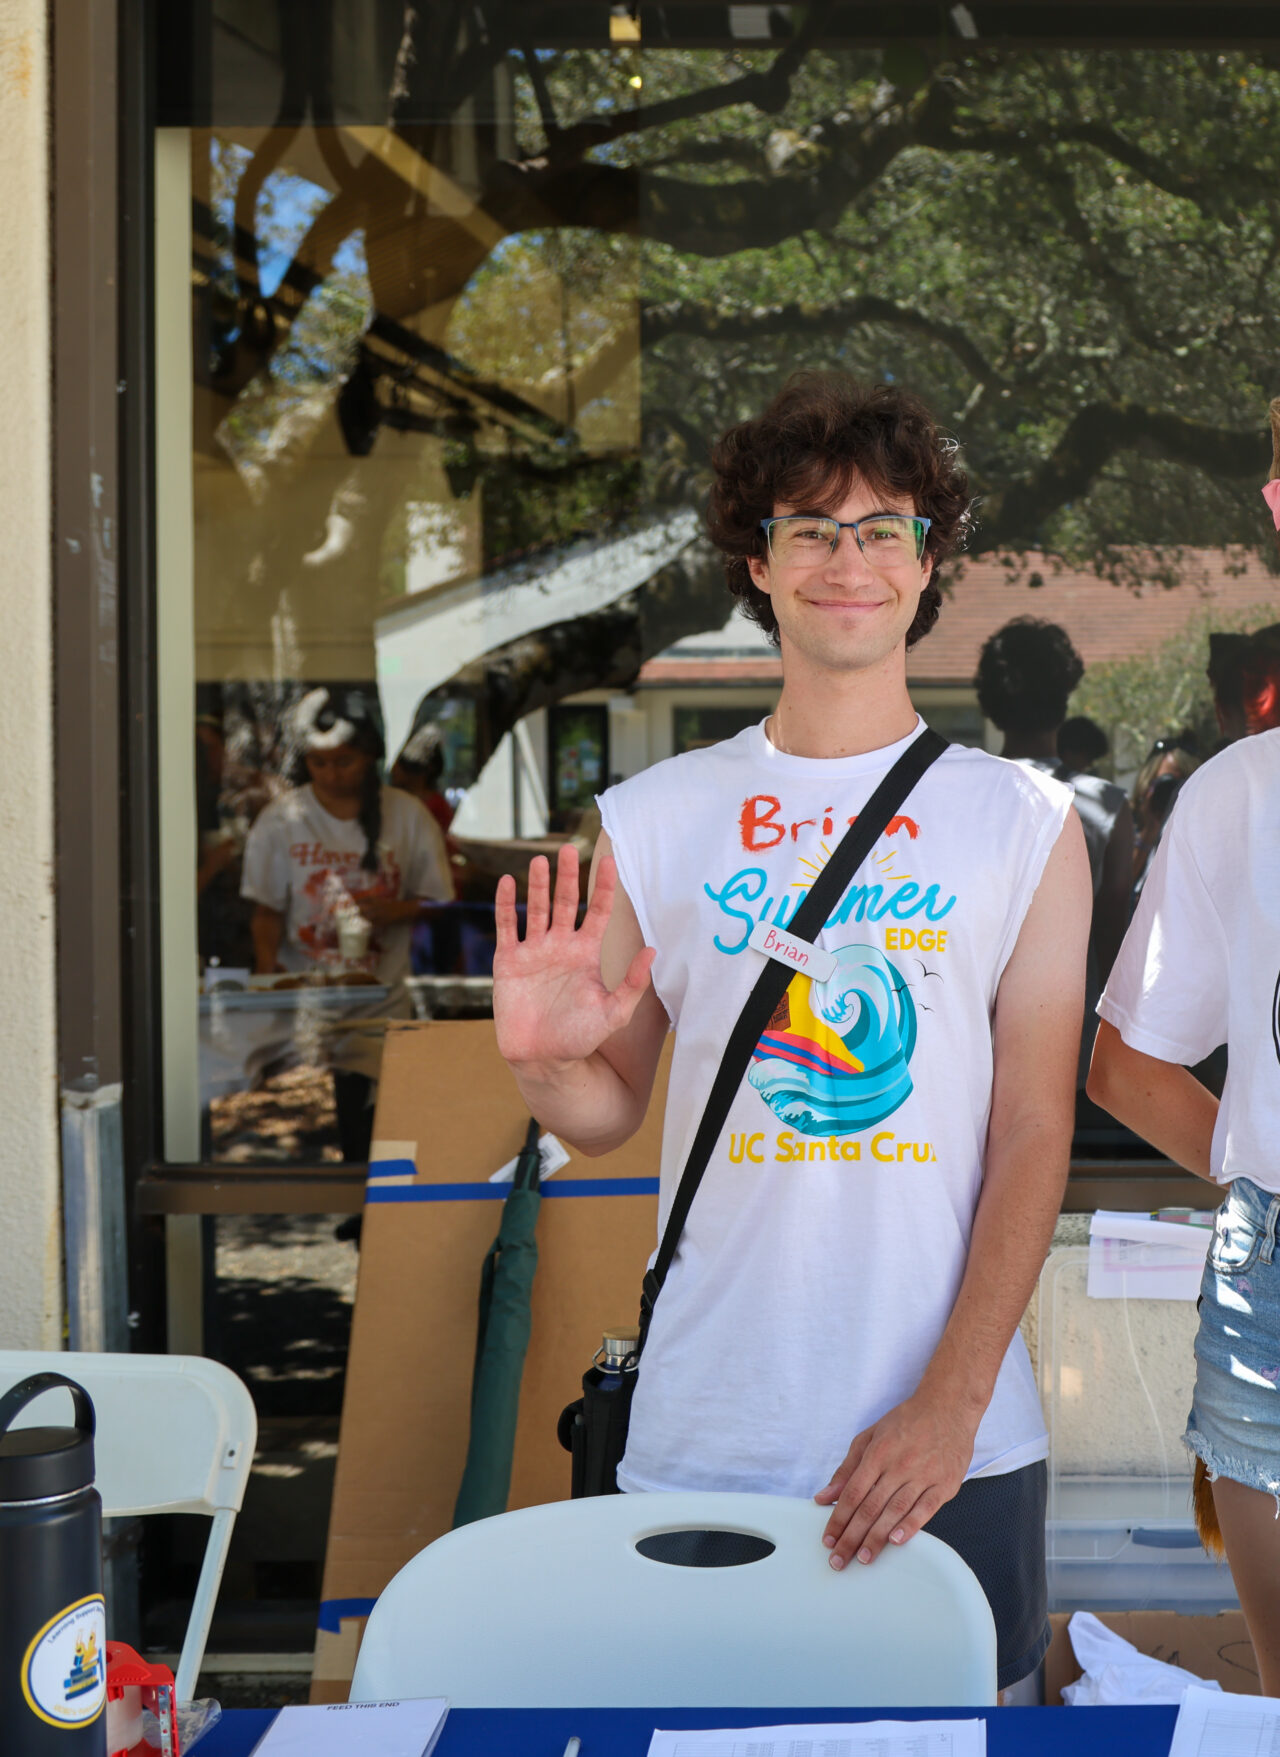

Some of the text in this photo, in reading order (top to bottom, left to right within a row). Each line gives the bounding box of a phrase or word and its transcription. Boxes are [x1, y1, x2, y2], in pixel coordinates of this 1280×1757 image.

[738, 795, 921, 852] Brin
[703, 867, 957, 955] Sumer
[763, 929, 809, 967] Brian
[885, 928, 948, 952] EDGE
[728, 1132, 765, 1163] UC
[774, 1131, 861, 1162] Santa
